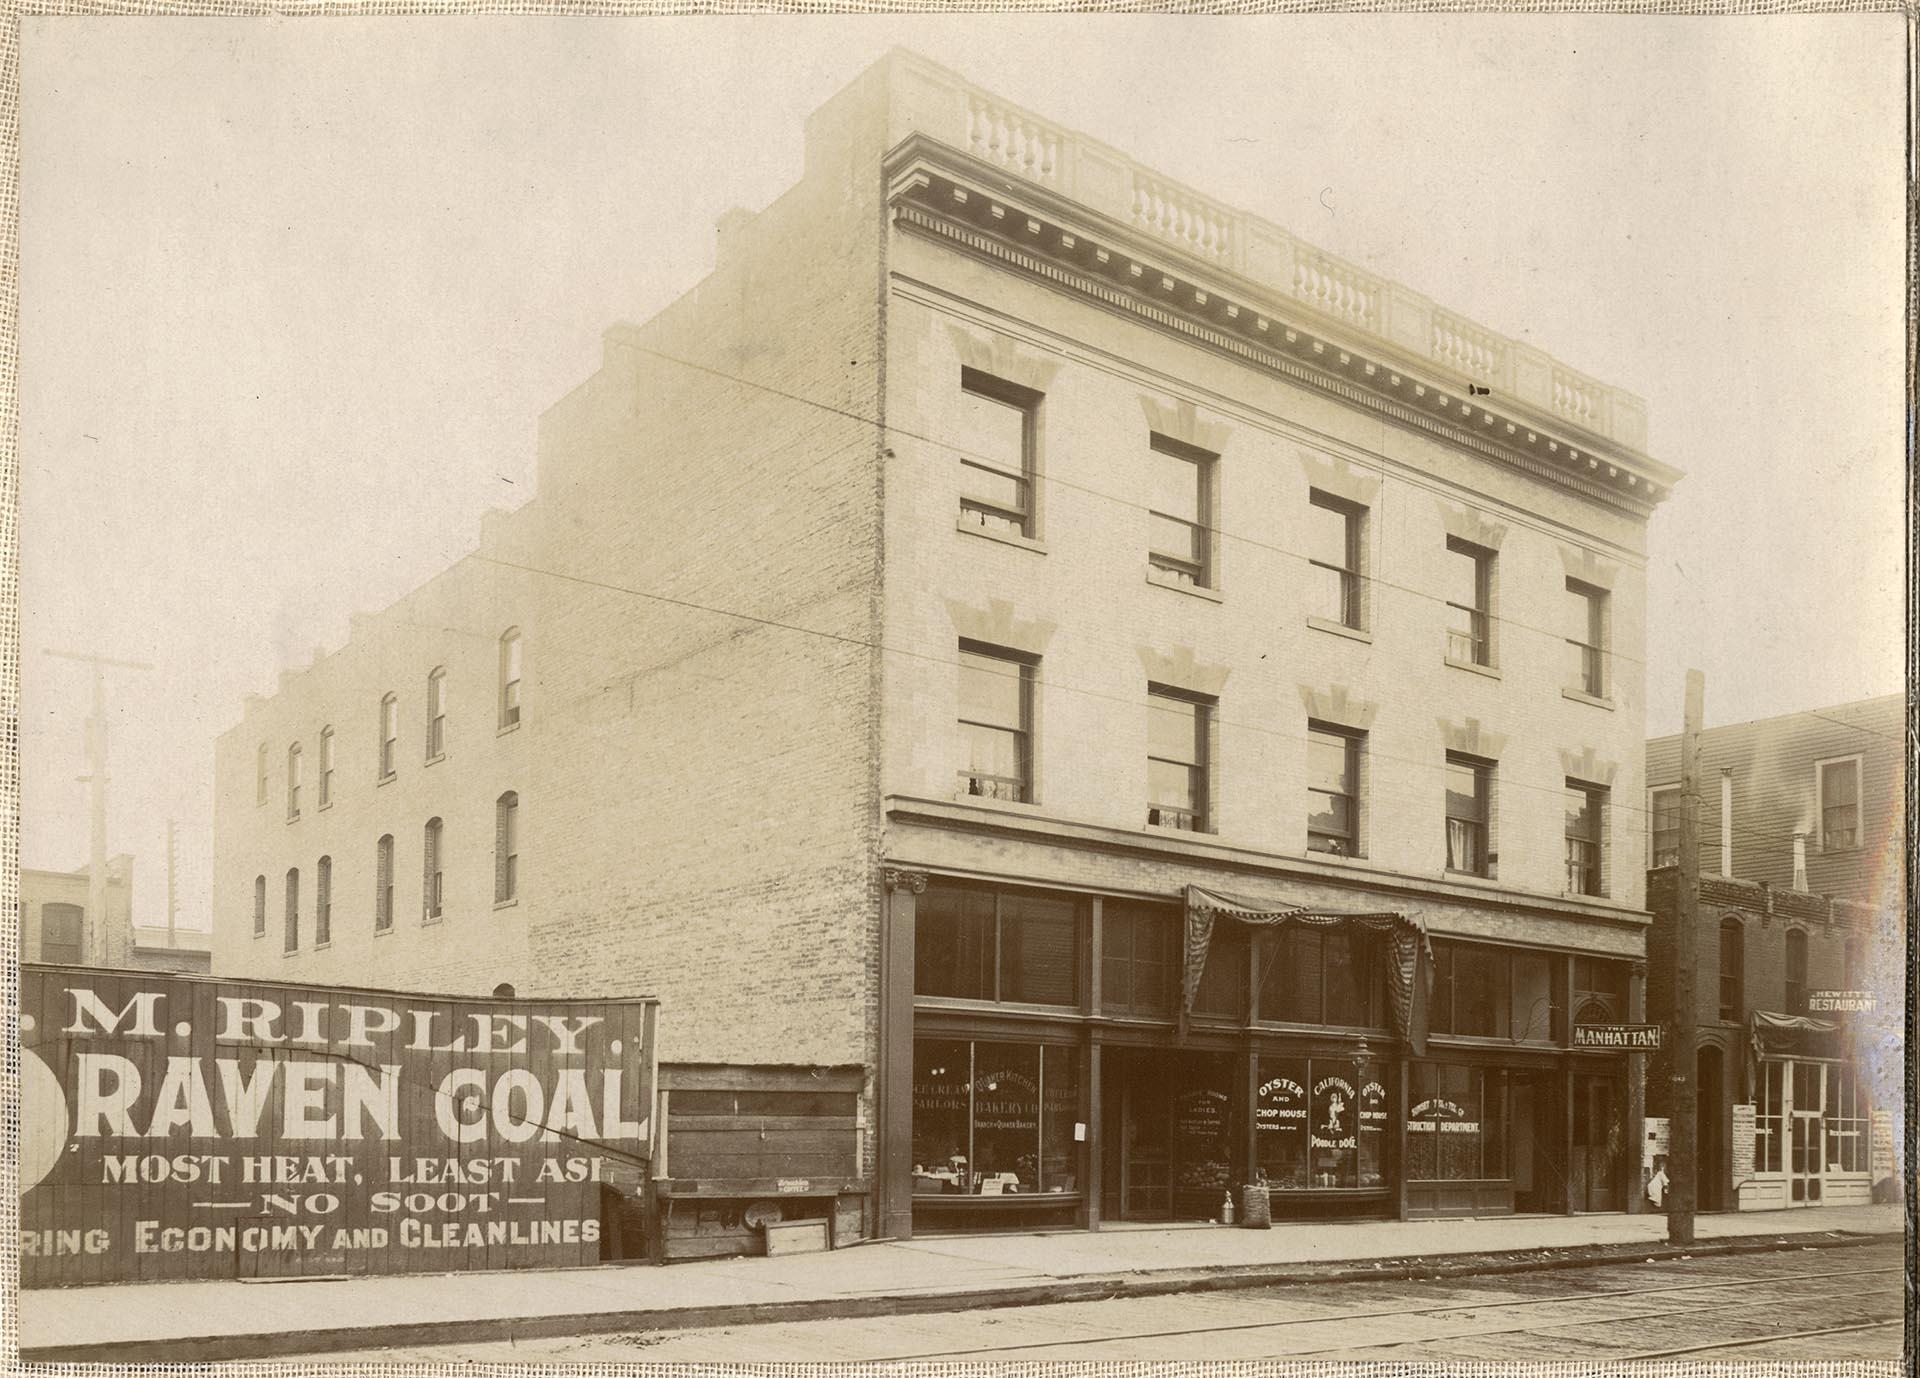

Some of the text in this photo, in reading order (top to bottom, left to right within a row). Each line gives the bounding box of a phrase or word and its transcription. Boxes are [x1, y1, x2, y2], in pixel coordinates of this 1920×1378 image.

[1808, 998, 1878, 1011] RESTAURANT
[215, 996, 624, 1055] RIPLEY.
[74, 1053, 649, 1143] RAVEN COAL
[1258, 1078, 1305, 1099] OYSTER
[1272, 1095, 1290, 1103] AND
[1313, 1077, 1356, 1100] CALIFORNIA
[1362, 1081, 1386, 1100] OYSTER
[1256, 1108, 1307, 1118] CHOP HOUSE
[1360, 1111, 1372, 1119] CHOP
[1311, 1134, 1338, 1149] POODLE
[101, 1155, 230, 1184] MOST
[242, 1155, 364, 1187] HEAT,
[389, 1156, 521, 1185] LEAST
[260, 1192, 500, 1215] NO SOOT
[135, 1220, 325, 1253] ECONOMY
[332, 1227, 389, 1250] AND
